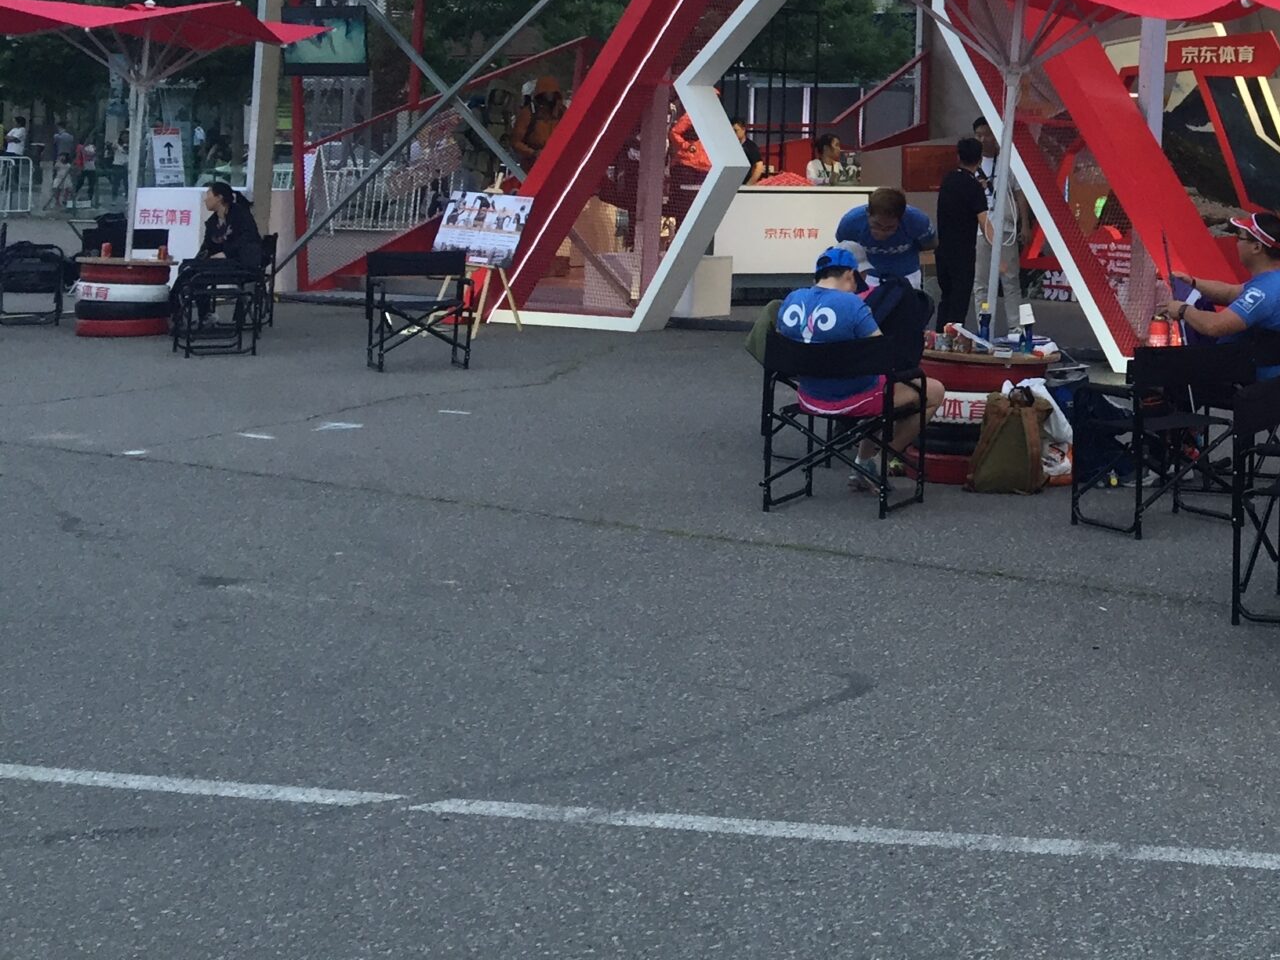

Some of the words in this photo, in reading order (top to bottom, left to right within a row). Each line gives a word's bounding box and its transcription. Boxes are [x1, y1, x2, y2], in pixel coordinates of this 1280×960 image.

[1181, 45, 1255, 64] 京东体育
[138, 208, 192, 226] 京东体育
[764, 227, 820, 240] 京东体育
